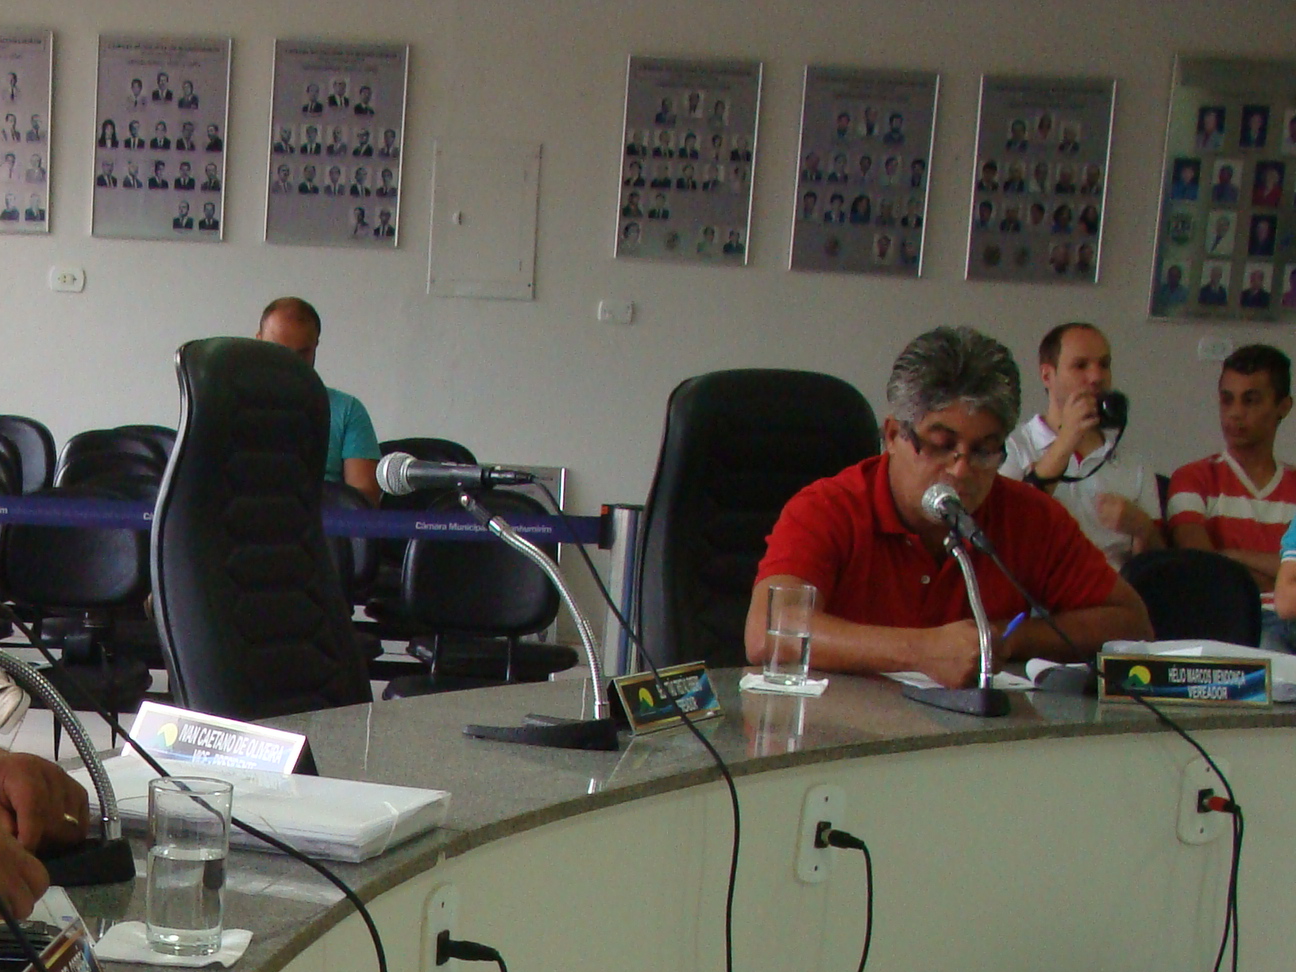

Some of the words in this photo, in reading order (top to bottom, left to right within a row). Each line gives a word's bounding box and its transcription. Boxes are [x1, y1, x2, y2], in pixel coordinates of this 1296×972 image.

[1187, 684, 1228, 700] VEREADOR
[179, 723, 201, 745] IVAN
[197, 727, 237, 753] CAETANO
[233, 734, 250, 757] DE
[244, 739, 285, 765] OLIVEIRA
